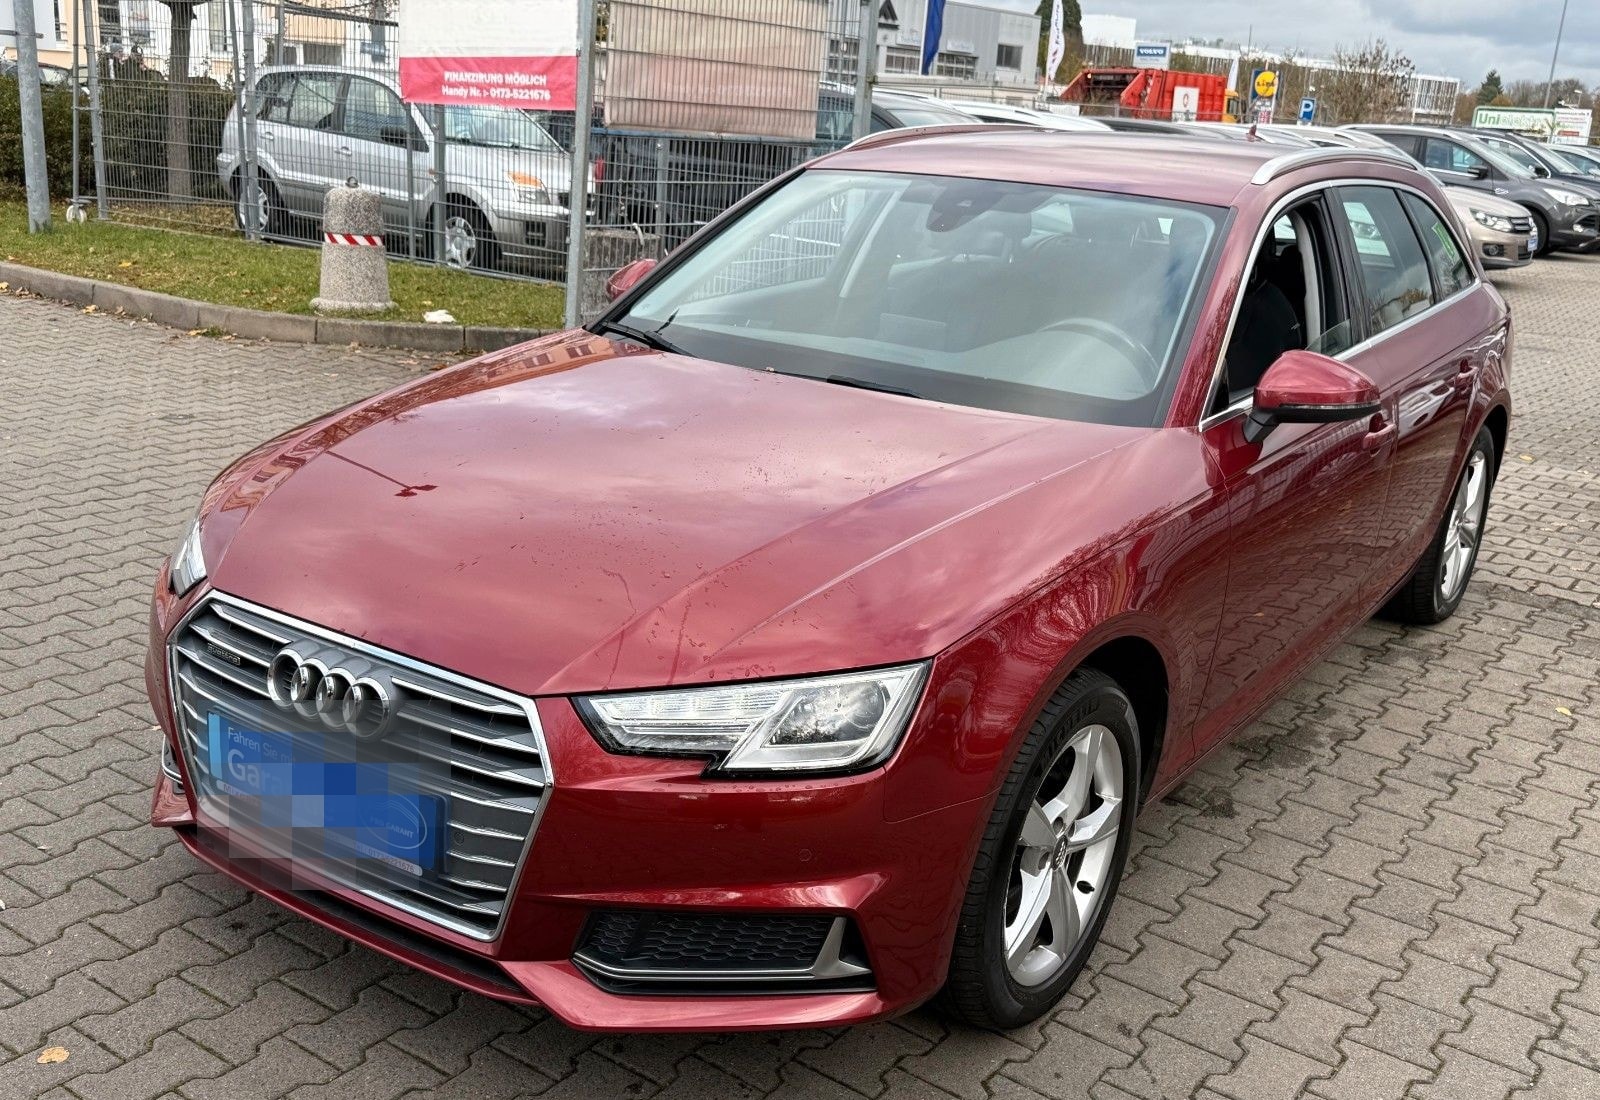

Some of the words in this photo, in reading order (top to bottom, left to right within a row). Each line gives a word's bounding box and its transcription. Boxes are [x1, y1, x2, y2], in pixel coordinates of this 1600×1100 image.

[444, 71, 504, 84] FINANZIRUNG
[504, 72, 547, 87] MÖGLICH
[441, 85, 468, 99] Handy
[470, 86, 482, 97] Nr.
[490, 87, 552, 101] 0173-5221676
[1299, 100, 1314, 118] P
[227, 726, 260, 753] Fahren
[262, 741, 278, 760] Sie
